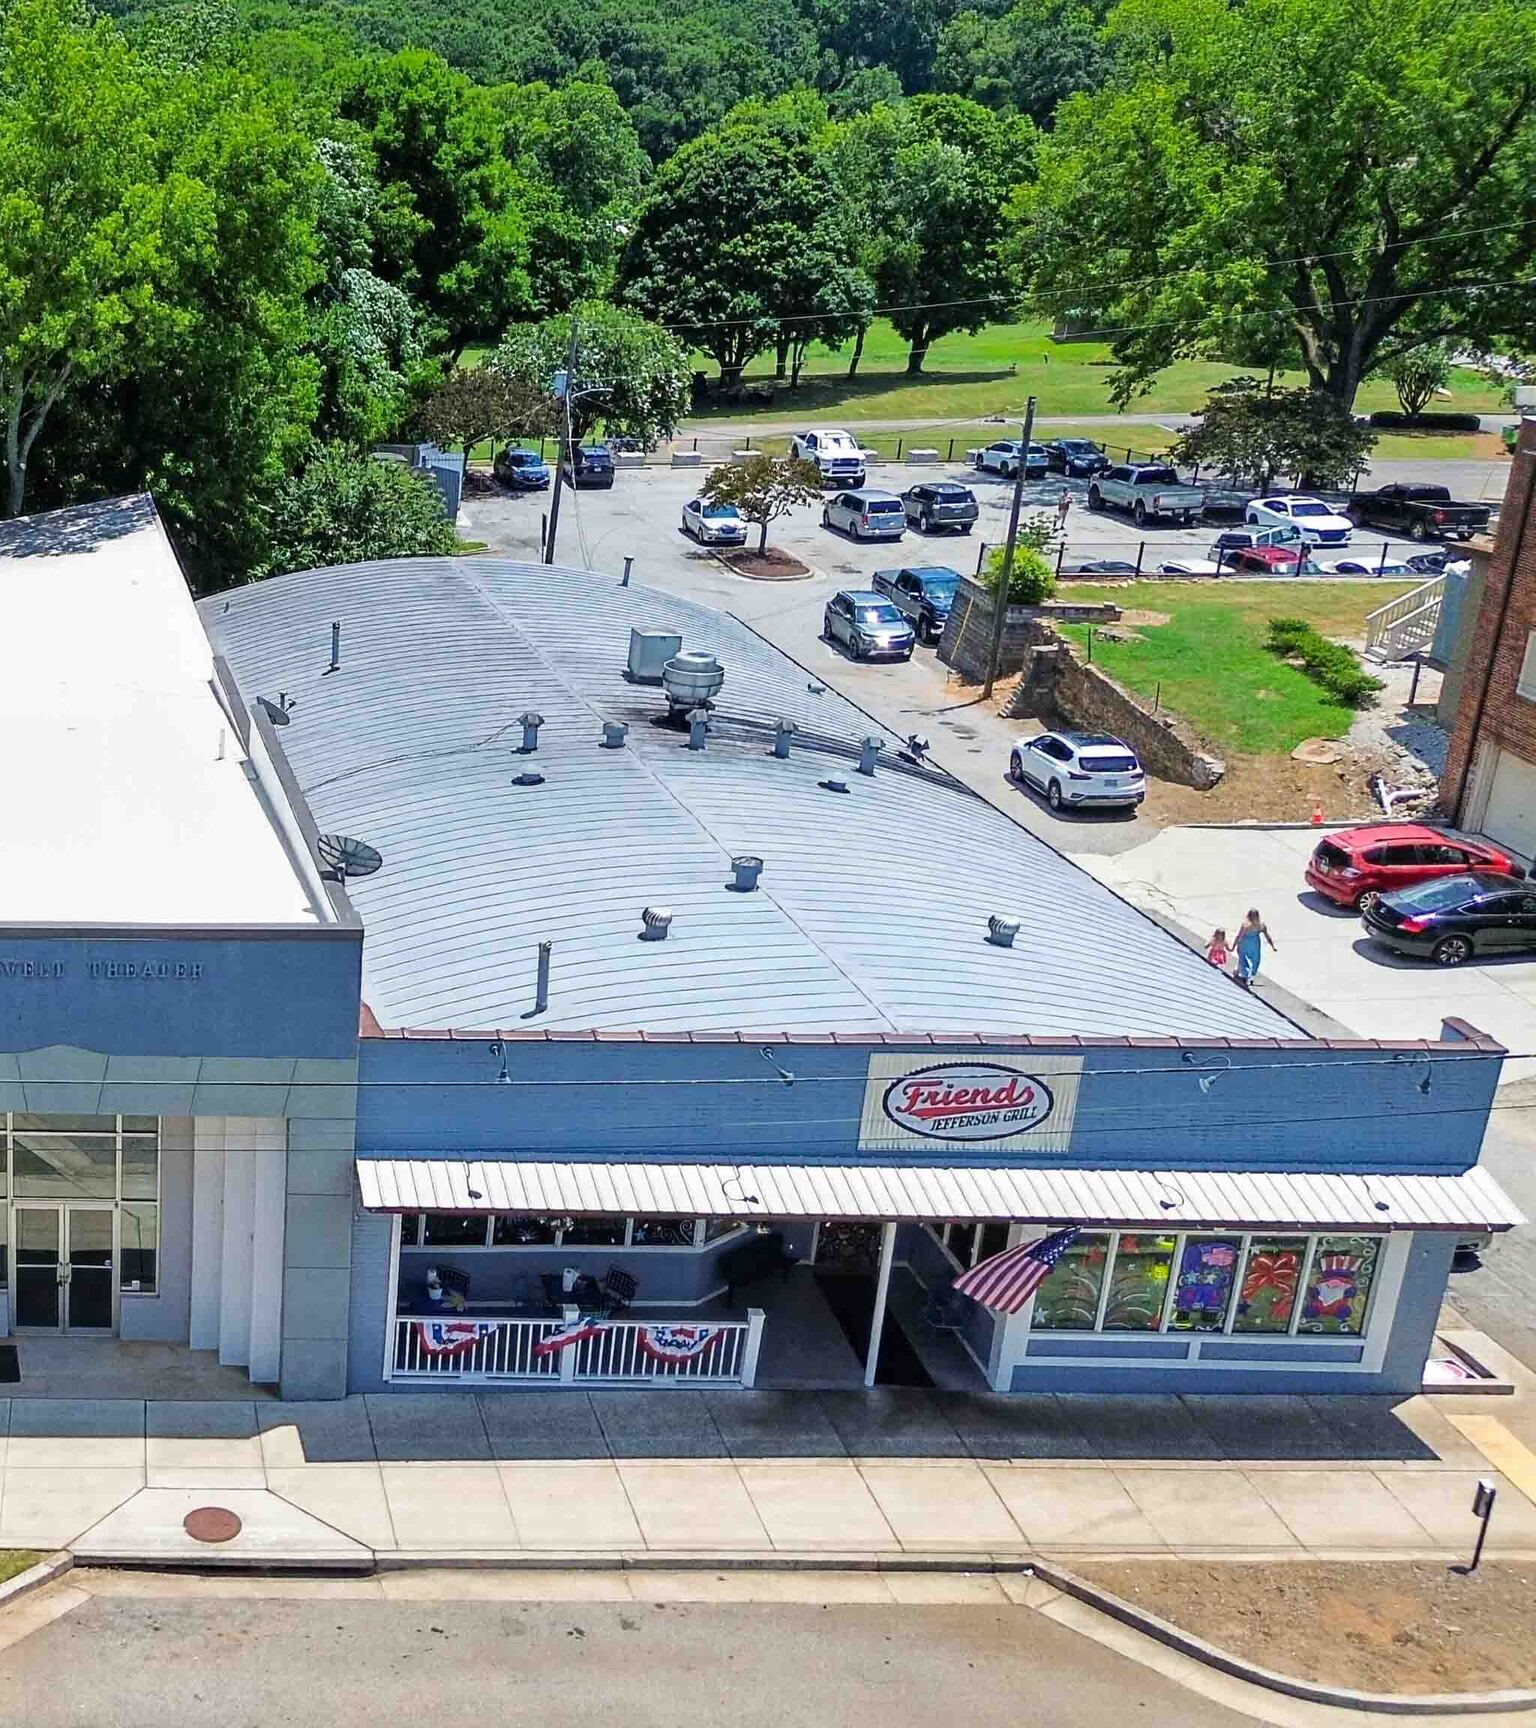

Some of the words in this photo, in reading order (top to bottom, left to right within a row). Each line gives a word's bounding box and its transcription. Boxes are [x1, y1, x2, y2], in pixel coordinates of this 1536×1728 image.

[88, 960, 204, 979] THEATER
[895, 1077, 1036, 1113] Friends
[929, 1112, 1000, 1132] JEFFERSON
[1003, 1105, 1038, 1121] GRILL
